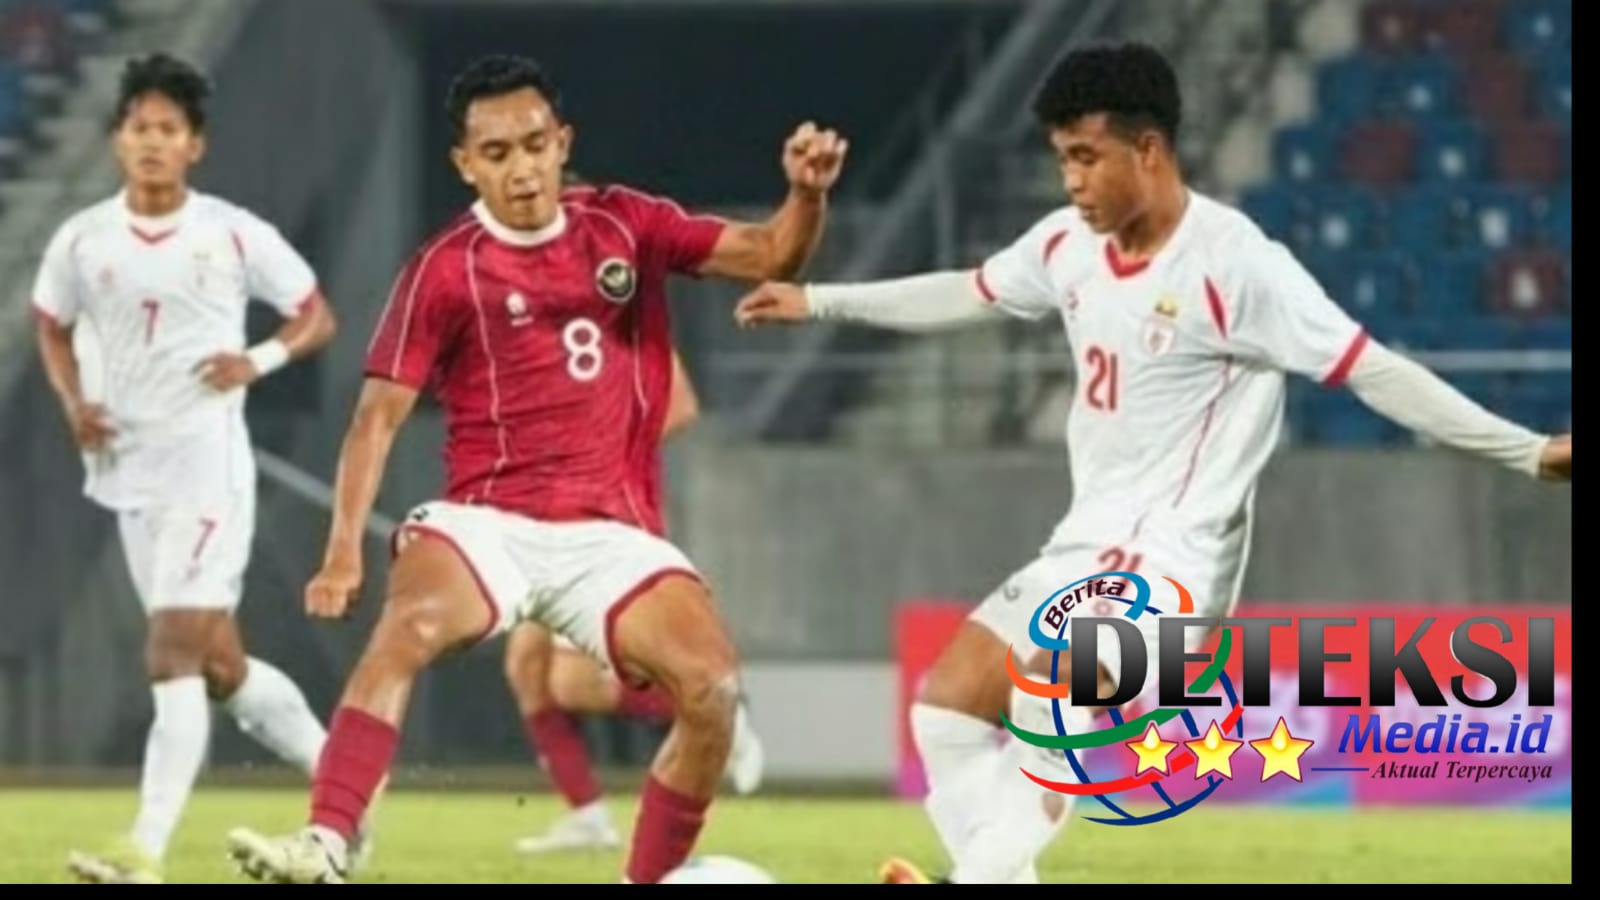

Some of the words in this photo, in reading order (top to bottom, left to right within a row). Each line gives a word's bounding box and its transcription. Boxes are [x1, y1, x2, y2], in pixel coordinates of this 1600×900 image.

[141, 299, 160, 344] 7
[563, 317, 604, 383] 8
[1085, 345, 1120, 411] 21
[192, 517, 216, 560] 7
